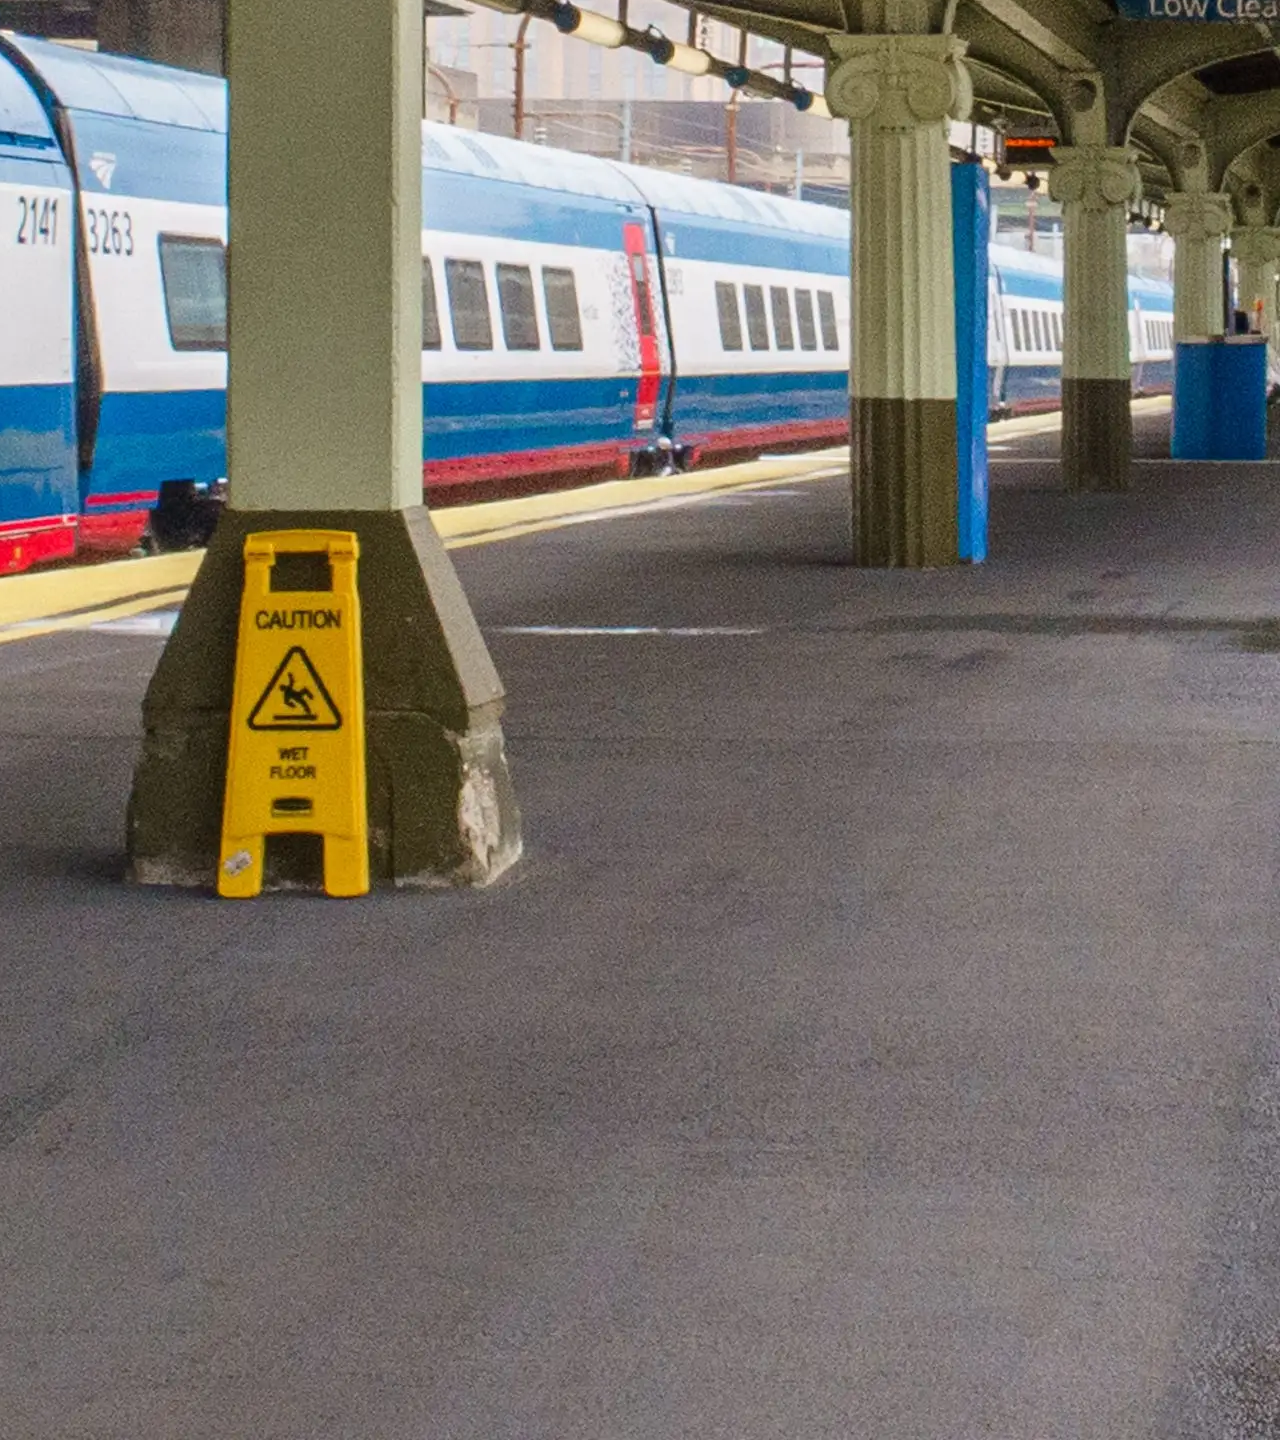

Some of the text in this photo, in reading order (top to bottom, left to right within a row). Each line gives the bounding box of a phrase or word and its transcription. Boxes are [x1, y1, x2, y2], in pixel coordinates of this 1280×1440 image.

[17, 195, 58, 245] 2141
[87, 208, 134, 256] 3263
[255, 610, 342, 630] CAUTION
[278, 747, 309, 761] WET
[269, 766, 316, 779] FLOOR
